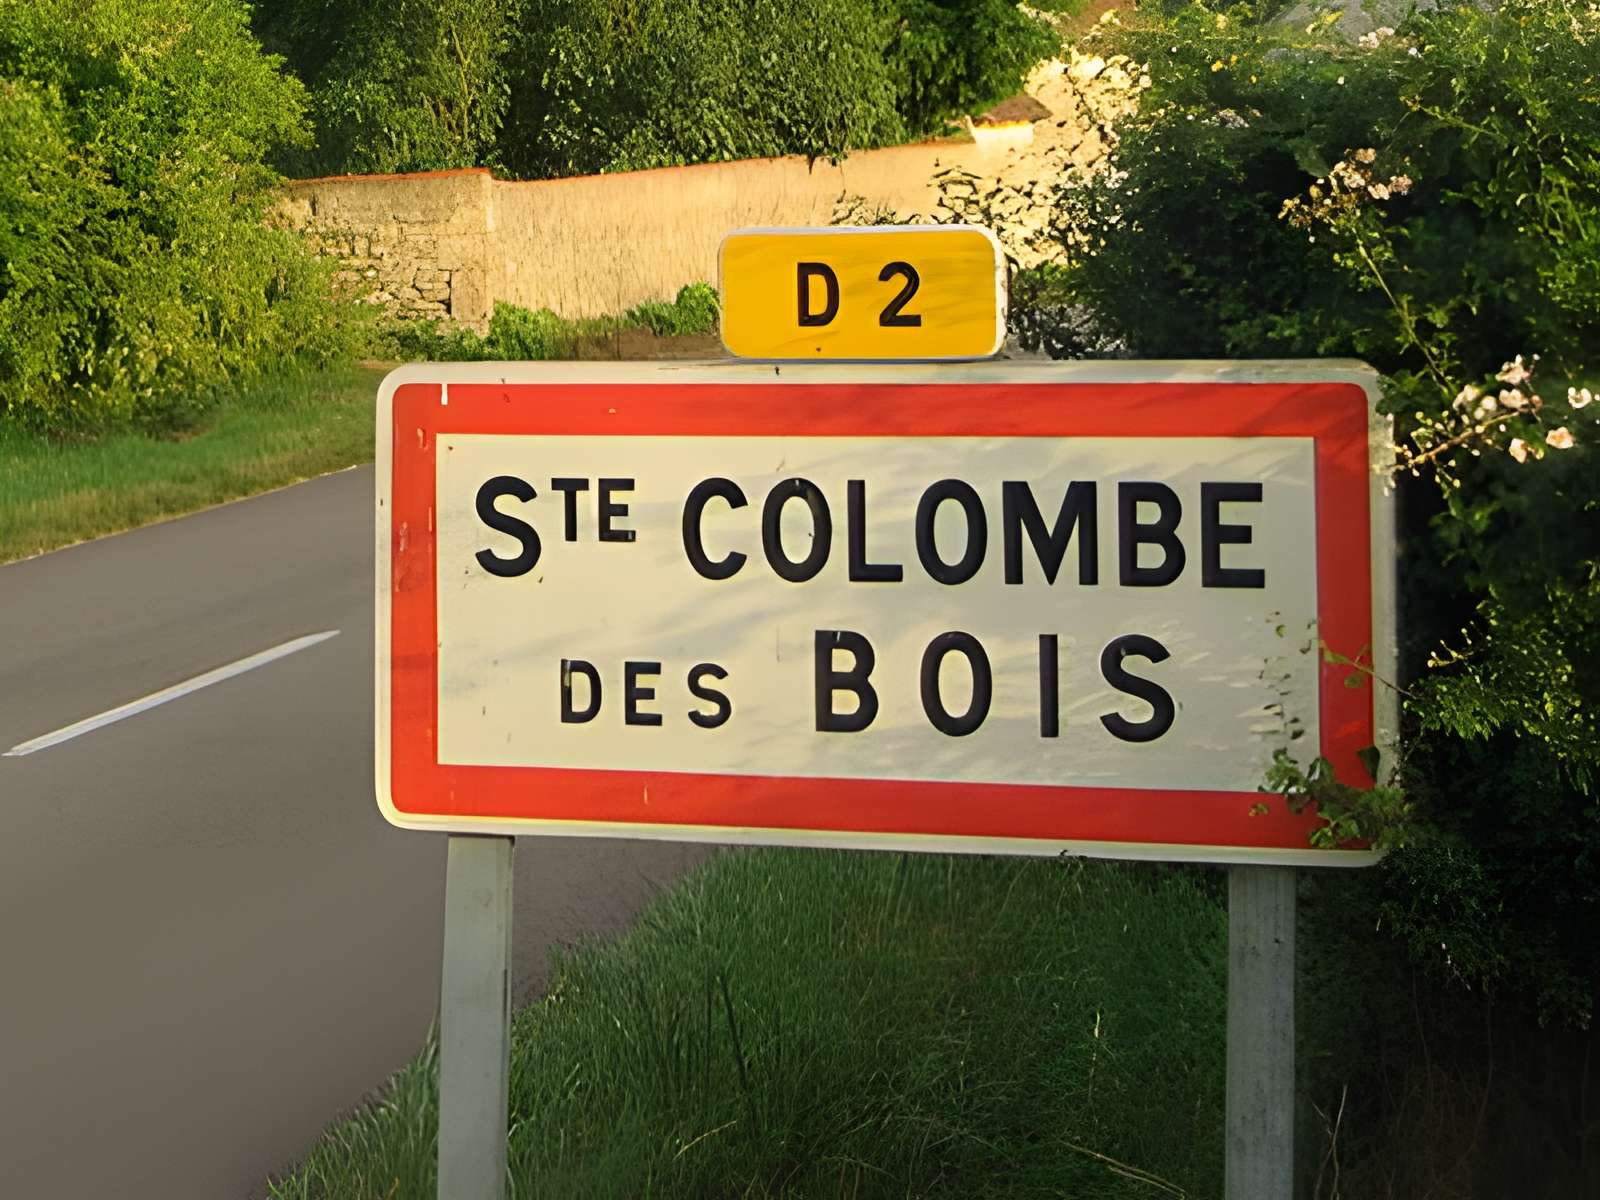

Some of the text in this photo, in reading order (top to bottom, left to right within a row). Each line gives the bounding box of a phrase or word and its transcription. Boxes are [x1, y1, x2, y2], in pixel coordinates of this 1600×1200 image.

[796, 260, 923, 328] D 2
[474, 475, 1267, 590] STE COLOMBE
[559, 629, 1177, 744] DES BOIS
